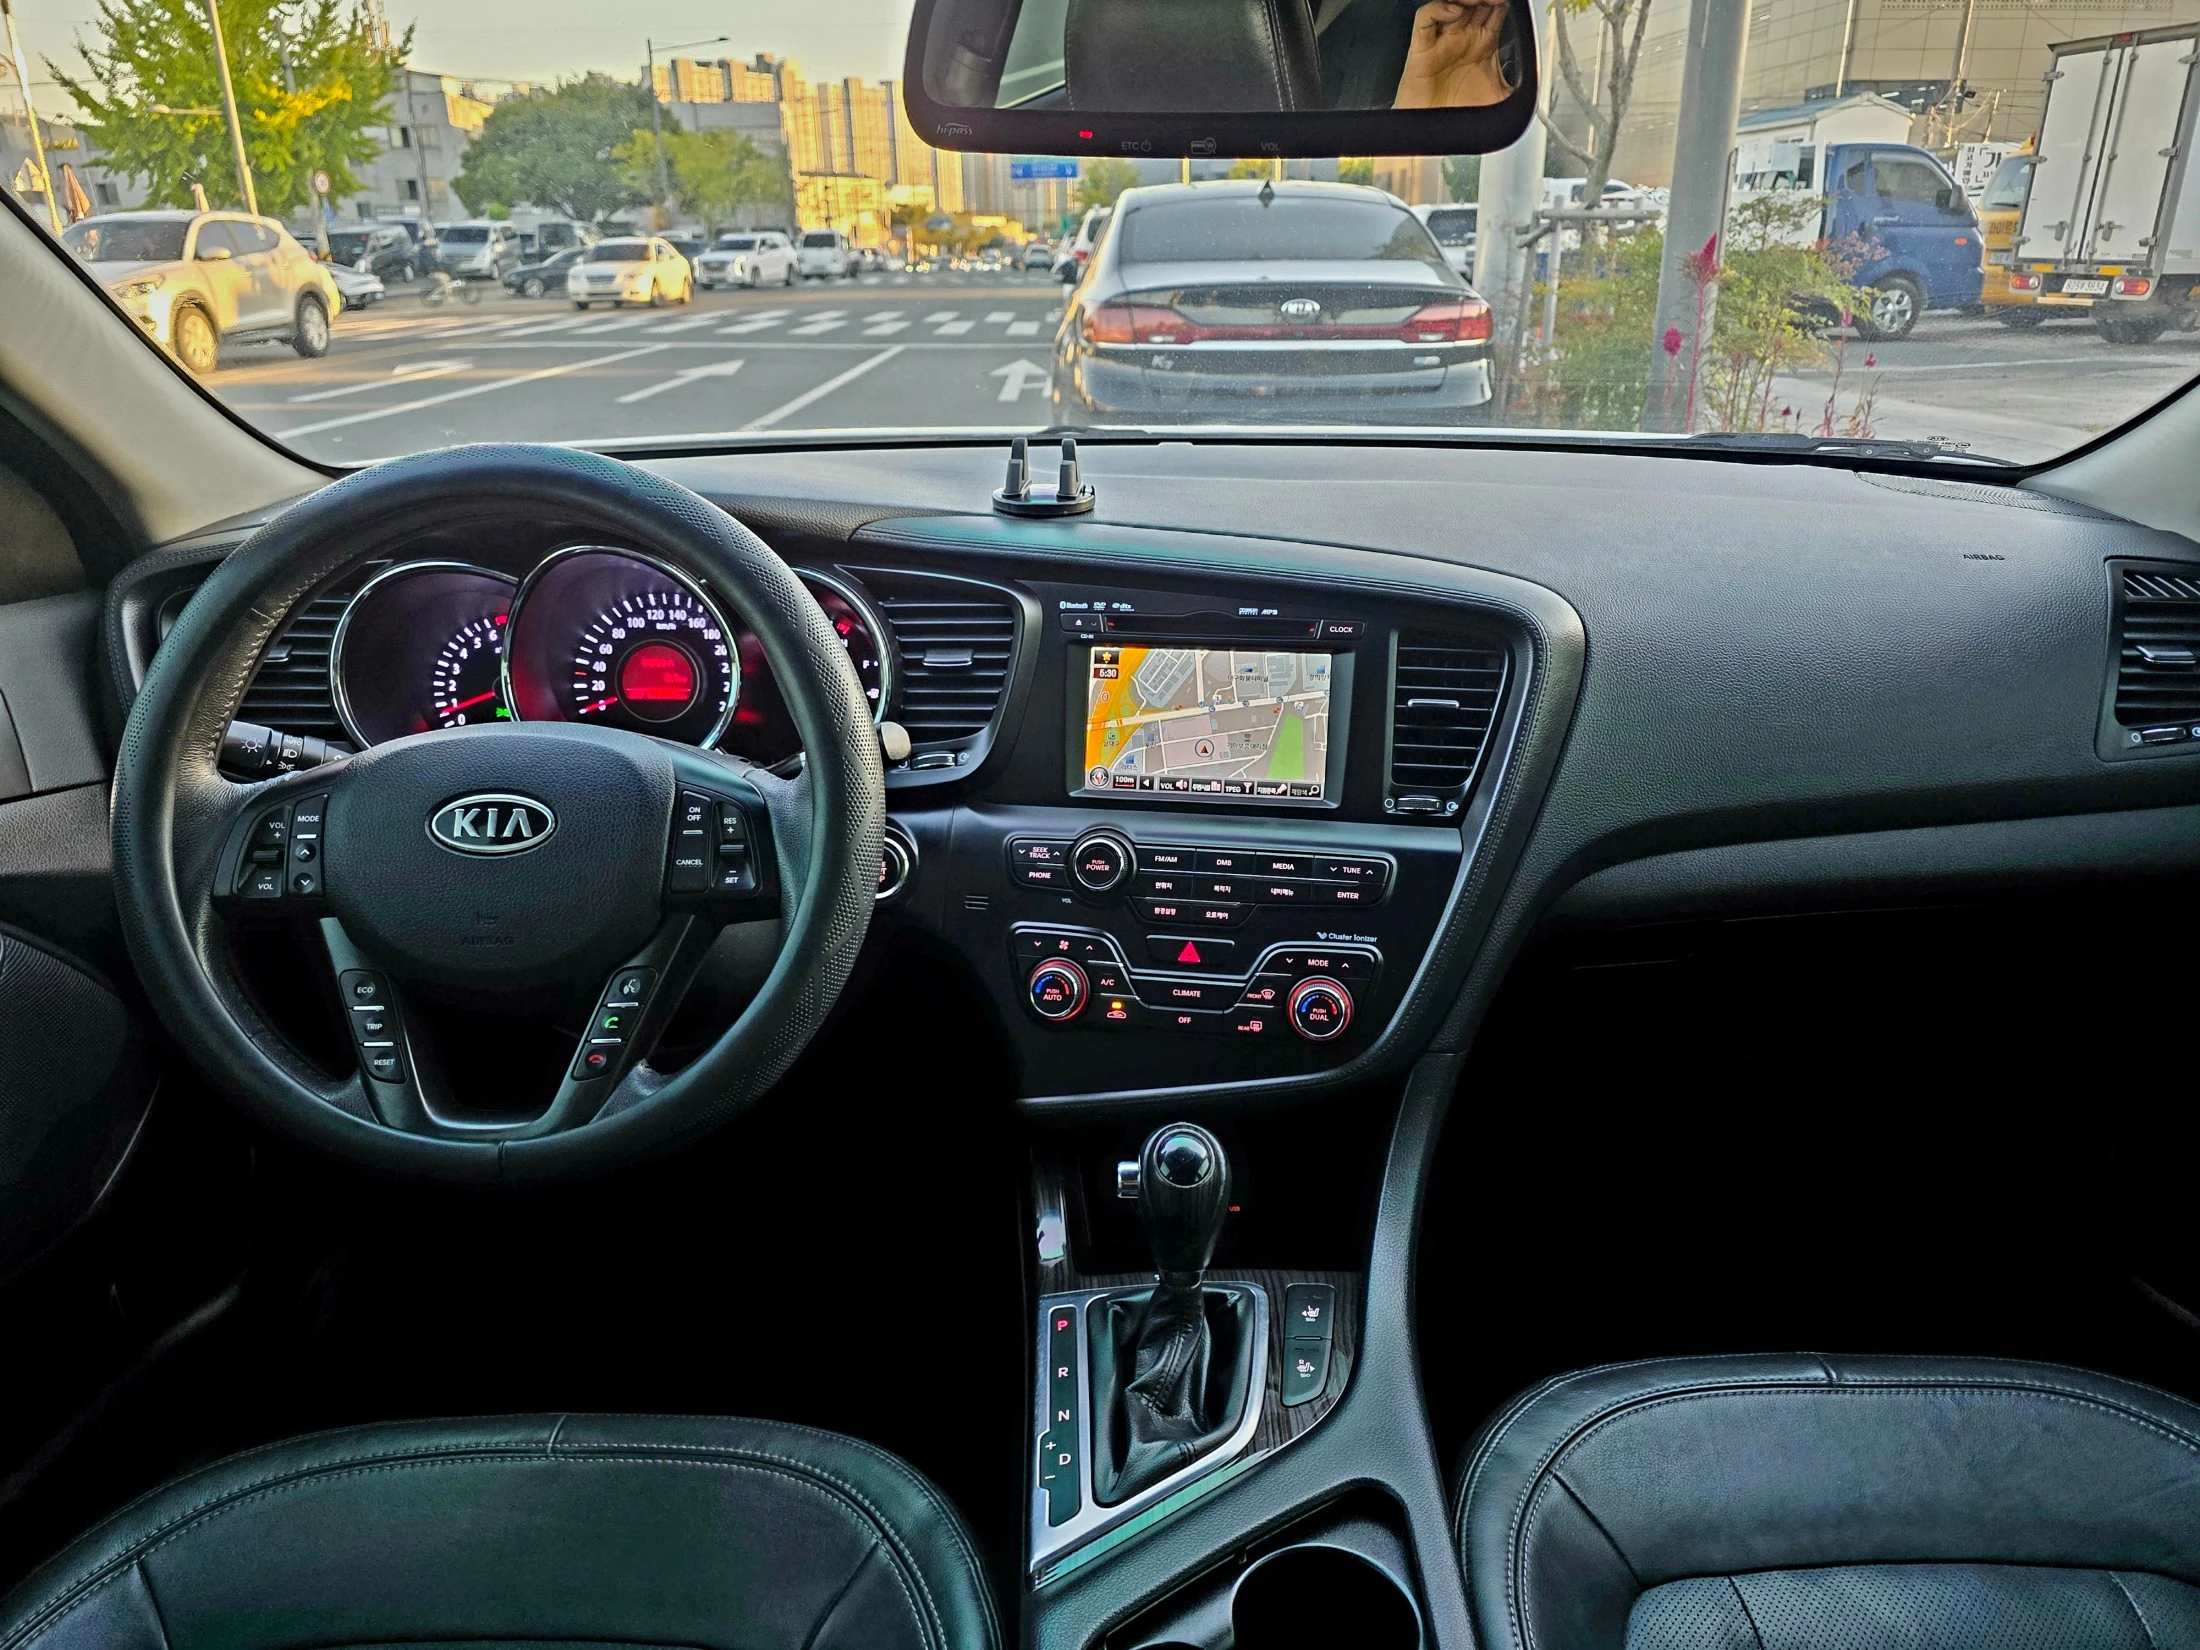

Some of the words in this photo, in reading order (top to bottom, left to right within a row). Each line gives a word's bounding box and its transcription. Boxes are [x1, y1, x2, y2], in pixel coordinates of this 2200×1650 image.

[1121, 141, 1140, 151] ETC
[1260, 142, 1281, 151] VOL
[1963, 553, 2005, 561] AIRBAG
[647, 609, 665, 621] 120
[669, 609, 687, 621] 140
[627, 617, 645, 629] 100
[656, 623, 677, 631] km/h
[688, 618, 706, 629] 160
[489, 629, 498, 642] 6
[612, 628, 626, 640] 80
[703, 629, 721, 640] 180
[474, 637, 482, 649] 5
[460, 647, 468, 660] 4
[599, 643, 613, 655] 60
[452, 663, 460, 675] 3
[592, 661, 607, 673] 40
[862, 659, 870, 669] F
[448, 680, 457, 692] 2
[591, 680, 606, 692] 20
[451, 698, 458, 708] 1
[457, 714, 466, 726] 0
[284, 738, 303, 746] AUTO
[1160, 782, 1175, 790] VOL
[453, 808, 533, 838] KIA
[723, 817, 737, 825] RES
[1154, 855, 1178, 863] FM/AM
[1085, 863, 1110, 871] POWER
[1272, 862, 1295, 871] MEDIA
[1342, 866, 1362, 874] TUNE
[1028, 871, 1052, 879] PHONE
[1337, 891, 1360, 900] ENTER
[1328, 932, 1353, 942] Cluster
[1307, 959, 1329, 967] MODE
[356, 986, 374, 994] ECO
[1172, 989, 1201, 997] CLIMATE
[1178, 1016, 1192, 1024] OFF
[1309, 1013, 1329, 1021] DUAL
[374, 1058, 395, 1066] RESET
[1057, 1319, 1069, 1332] P
[1058, 1367, 1069, 1378] R
[1058, 1409, 1070, 1422] N
[1059, 1453, 1072, 1466] D
